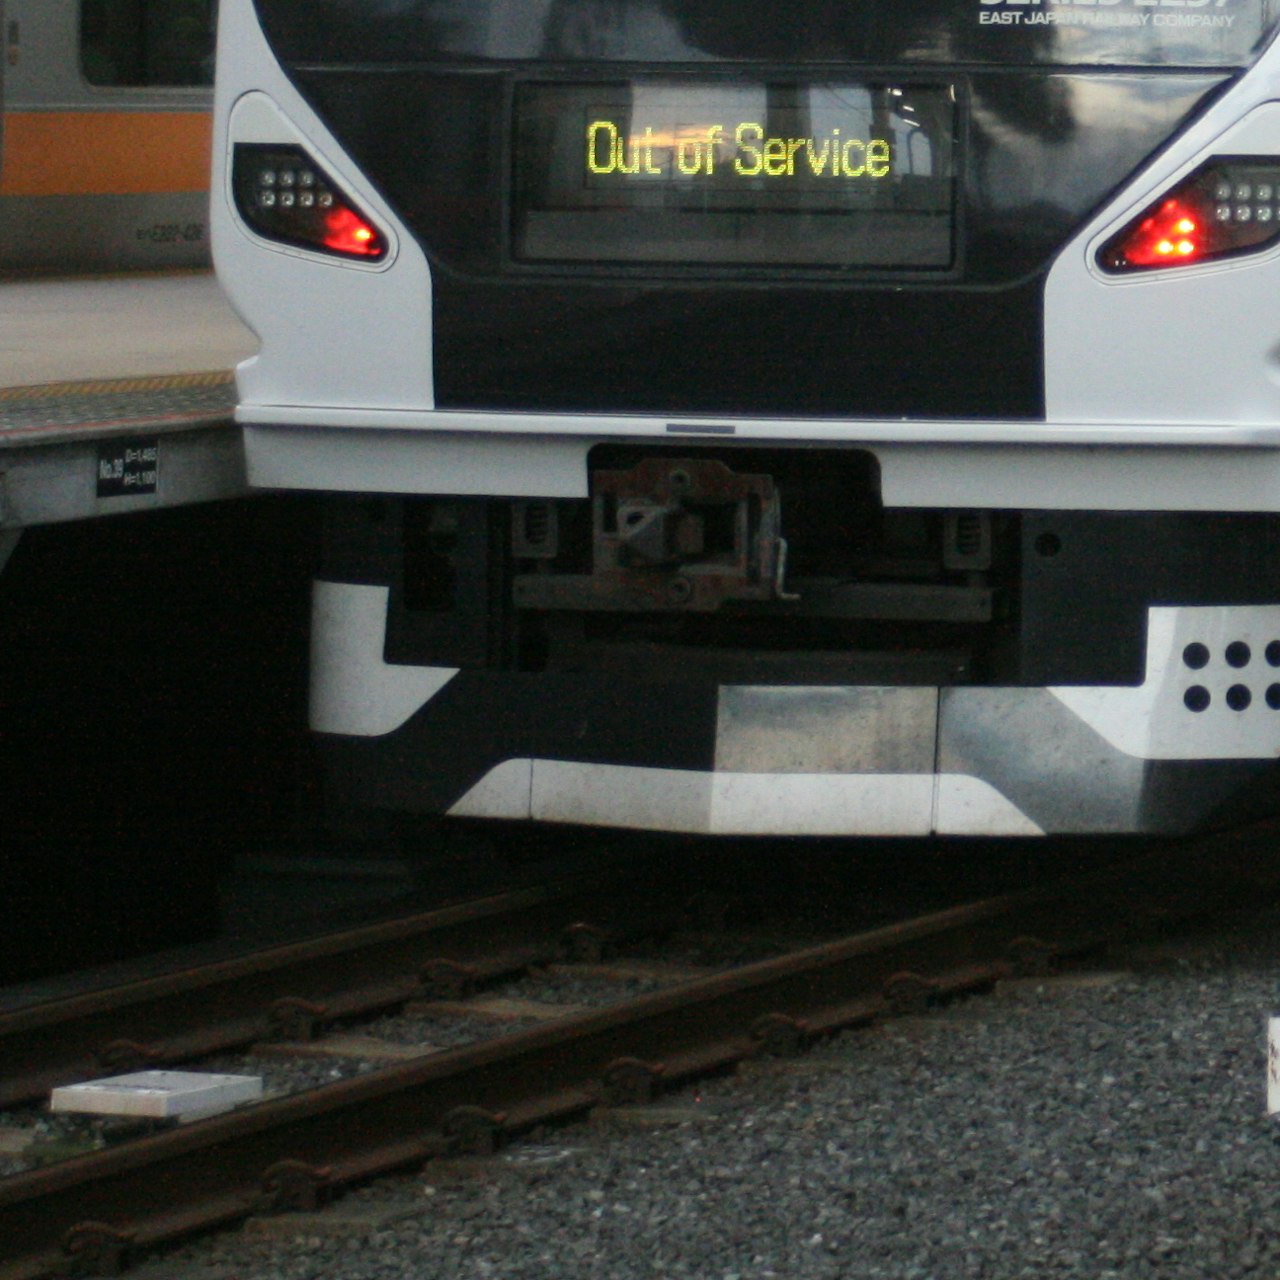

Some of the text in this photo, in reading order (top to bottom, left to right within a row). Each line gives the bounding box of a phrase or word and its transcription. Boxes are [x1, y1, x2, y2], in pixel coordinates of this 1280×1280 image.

[978, 11, 1237, 29] EAST JAPAN RAILWAY COMPANY
[586, 120, 890, 178] Out of Service
